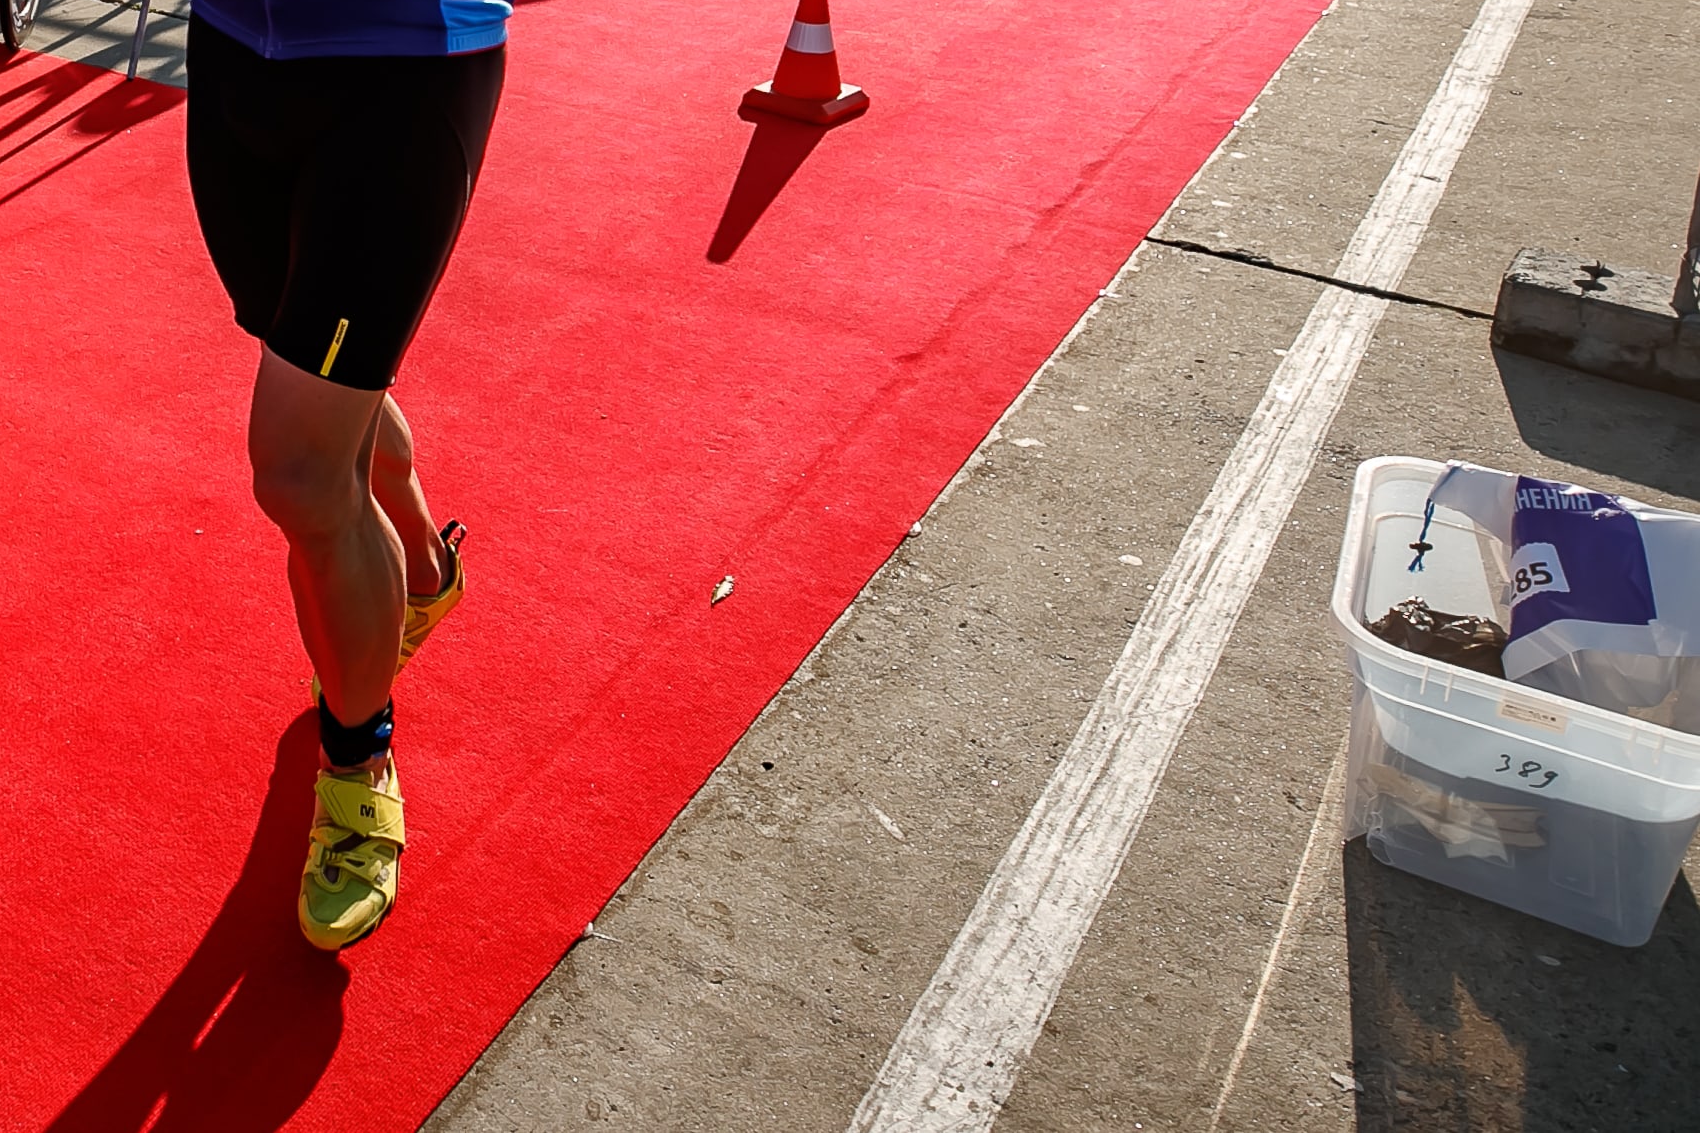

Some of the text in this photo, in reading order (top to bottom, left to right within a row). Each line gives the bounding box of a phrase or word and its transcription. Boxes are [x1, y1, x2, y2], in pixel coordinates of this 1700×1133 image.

[1515, 488, 1592, 512] НЕНИЯ
[1511, 561, 1554, 601] 85
[1495, 753, 1559, 789] 389
